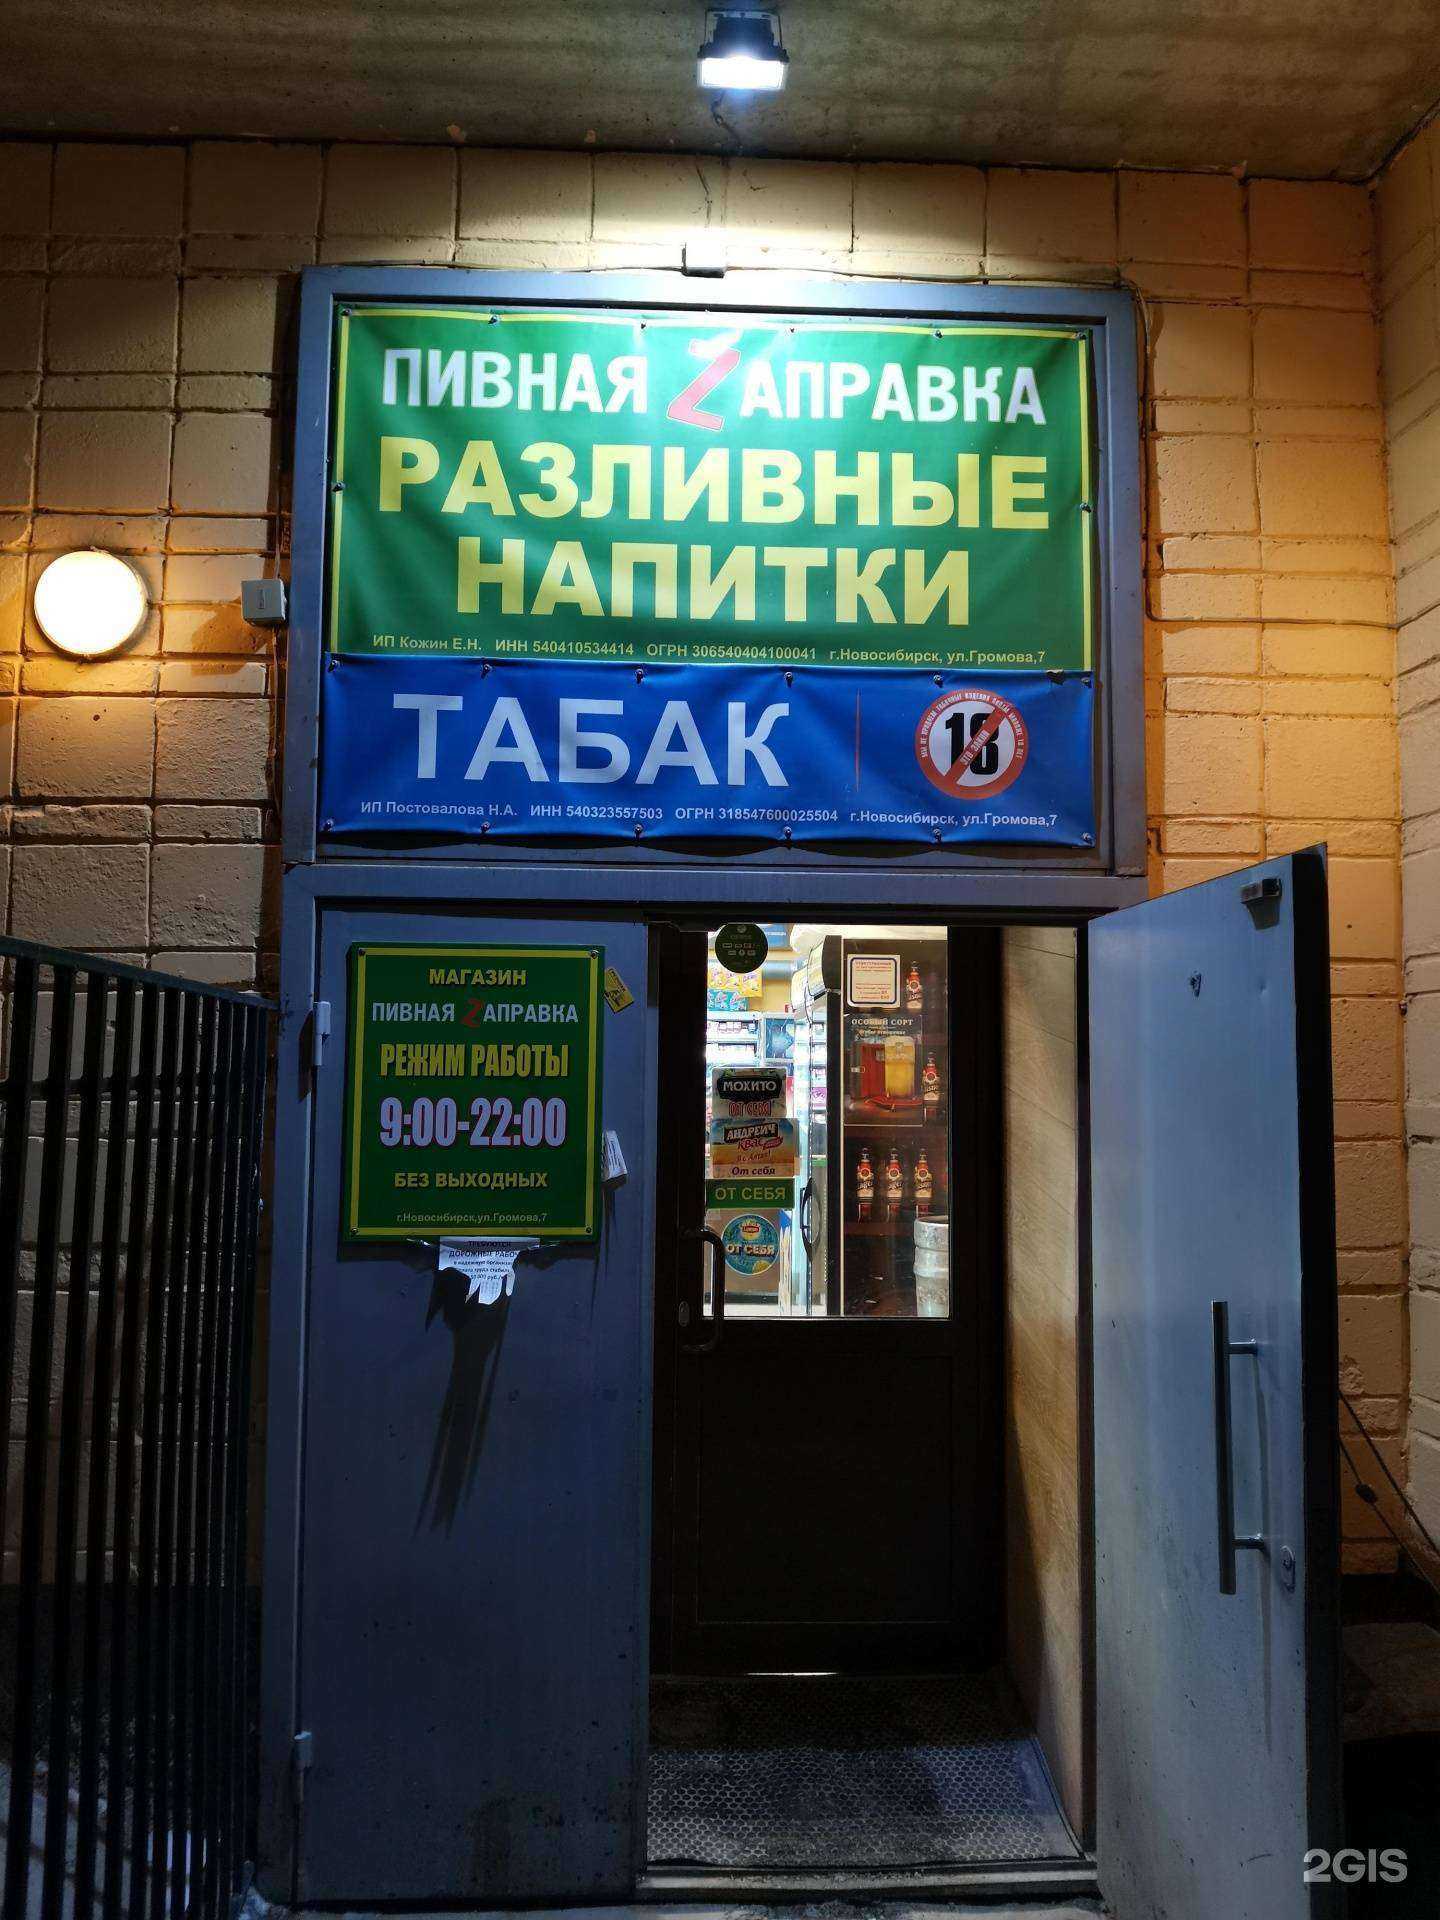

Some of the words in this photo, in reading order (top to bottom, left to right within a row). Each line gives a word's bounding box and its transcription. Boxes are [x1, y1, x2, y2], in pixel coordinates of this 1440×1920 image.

[381, 347, 650, 415] ПИВНАЯ
[378, 435, 1050, 530] РАЗЛИВНЫЕ
[457, 536, 970, 626] НАПИТКИ
[373, 635, 395, 648] ИП
[400, 636, 448, 650] Кожин
[453, 638, 482, 651] Е.Н.
[496, 639, 528, 653] ИНН
[532, 640, 634, 656] 540410534414
[647, 643, 687, 657] ОГРН
[692, 644, 816, 660] 306540404100041
[830, 649, 942, 663] г.Новосибирск,
[947, 650, 1046, 665] ул.Громова,7
[394, 692, 790, 788] ТАБАК
[945, 713, 999, 775] 18
[361, 801, 382, 814] ИП
[386, 801, 484, 816] Постовалова
[489, 803, 518, 817] Н.А.
[530, 804, 562, 817] ИНН
[566, 805, 663, 820] 540323557503
[675, 806, 714, 820] ОГРН
[718, 808, 838, 822] 318547600025504
[850, 810, 958, 826] г.Новосибирск,
[962, 812, 1058, 828] ул.Громова,7
[429, 968, 527, 985] МАГАЗИН
[372, 1002, 455, 1022] ПИВНАЯ
[891, 1018, 913, 1026] СОРТ
[380, 1043, 465, 1077] РЕЖИМ
[470, 1044, 569, 1077] РАБОТЫ
[723, 1080, 777, 1092] МОХИТО
[379, 1097, 567, 1147] 9:00-22:00
[394, 1172, 430, 1188] БЕЗ
[435, 1172, 548, 1190] ВЫХОДНЫХ
[732, 1166, 749, 1175] От
[751, 1165, 776, 1175] себя
[714, 1188, 737, 1200] ОТ
[741, 1187, 786, 1200] СЕБЯ
[449, 1250, 492, 1258] ДОРОЖНЫЕ
[727, 1244, 741, 1254] ОТ
[744, 1244, 775, 1255] СЕБЯ
